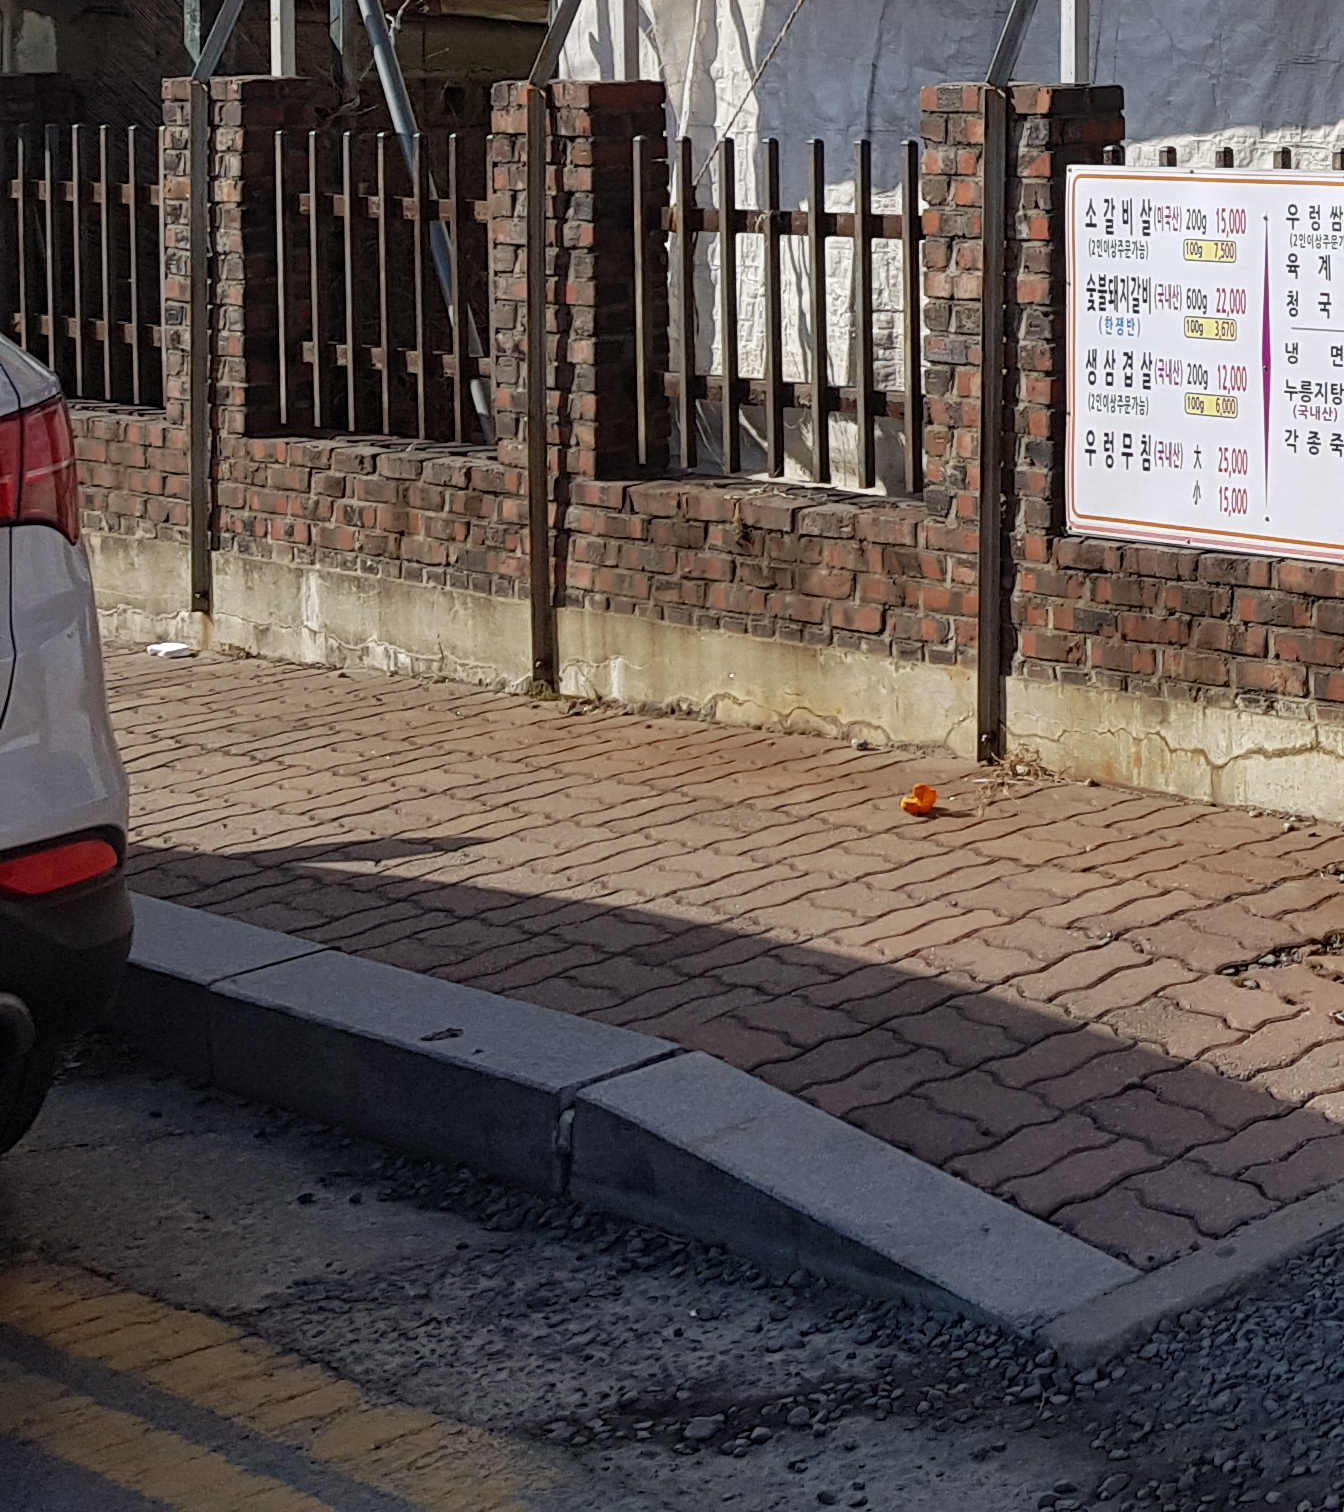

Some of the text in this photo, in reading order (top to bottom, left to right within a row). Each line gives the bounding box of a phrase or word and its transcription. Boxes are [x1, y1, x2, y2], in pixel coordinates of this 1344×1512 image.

[1085, 197, 1247, 238] 소갈비살 (미국산) 200g 15,000
[1185, 241, 1235, 260] 100g 7,500
[1086, 273, 1247, 317] 숯불돼지갈비 (국내산) 600g 22,000
[1186, 319, 1235, 338] 100g 3,670
[1285, 342, 1344, 368] 냉면
[1085, 348, 1247, 394] 생삼겹살 (국내산) 200g 12,000
[1187, 395, 1236, 416] 100g 6,000
[1292, 405, 1338, 422] (국내산)
[1084, 429, 1151, 472] 우렁무침
[1154, 440, 1183, 469] (국내산)
[1218, 446, 1248, 478] 25,000
[1284, 429, 1344, 457] 각종죽
[1218, 485, 1248, 517] 15,000
